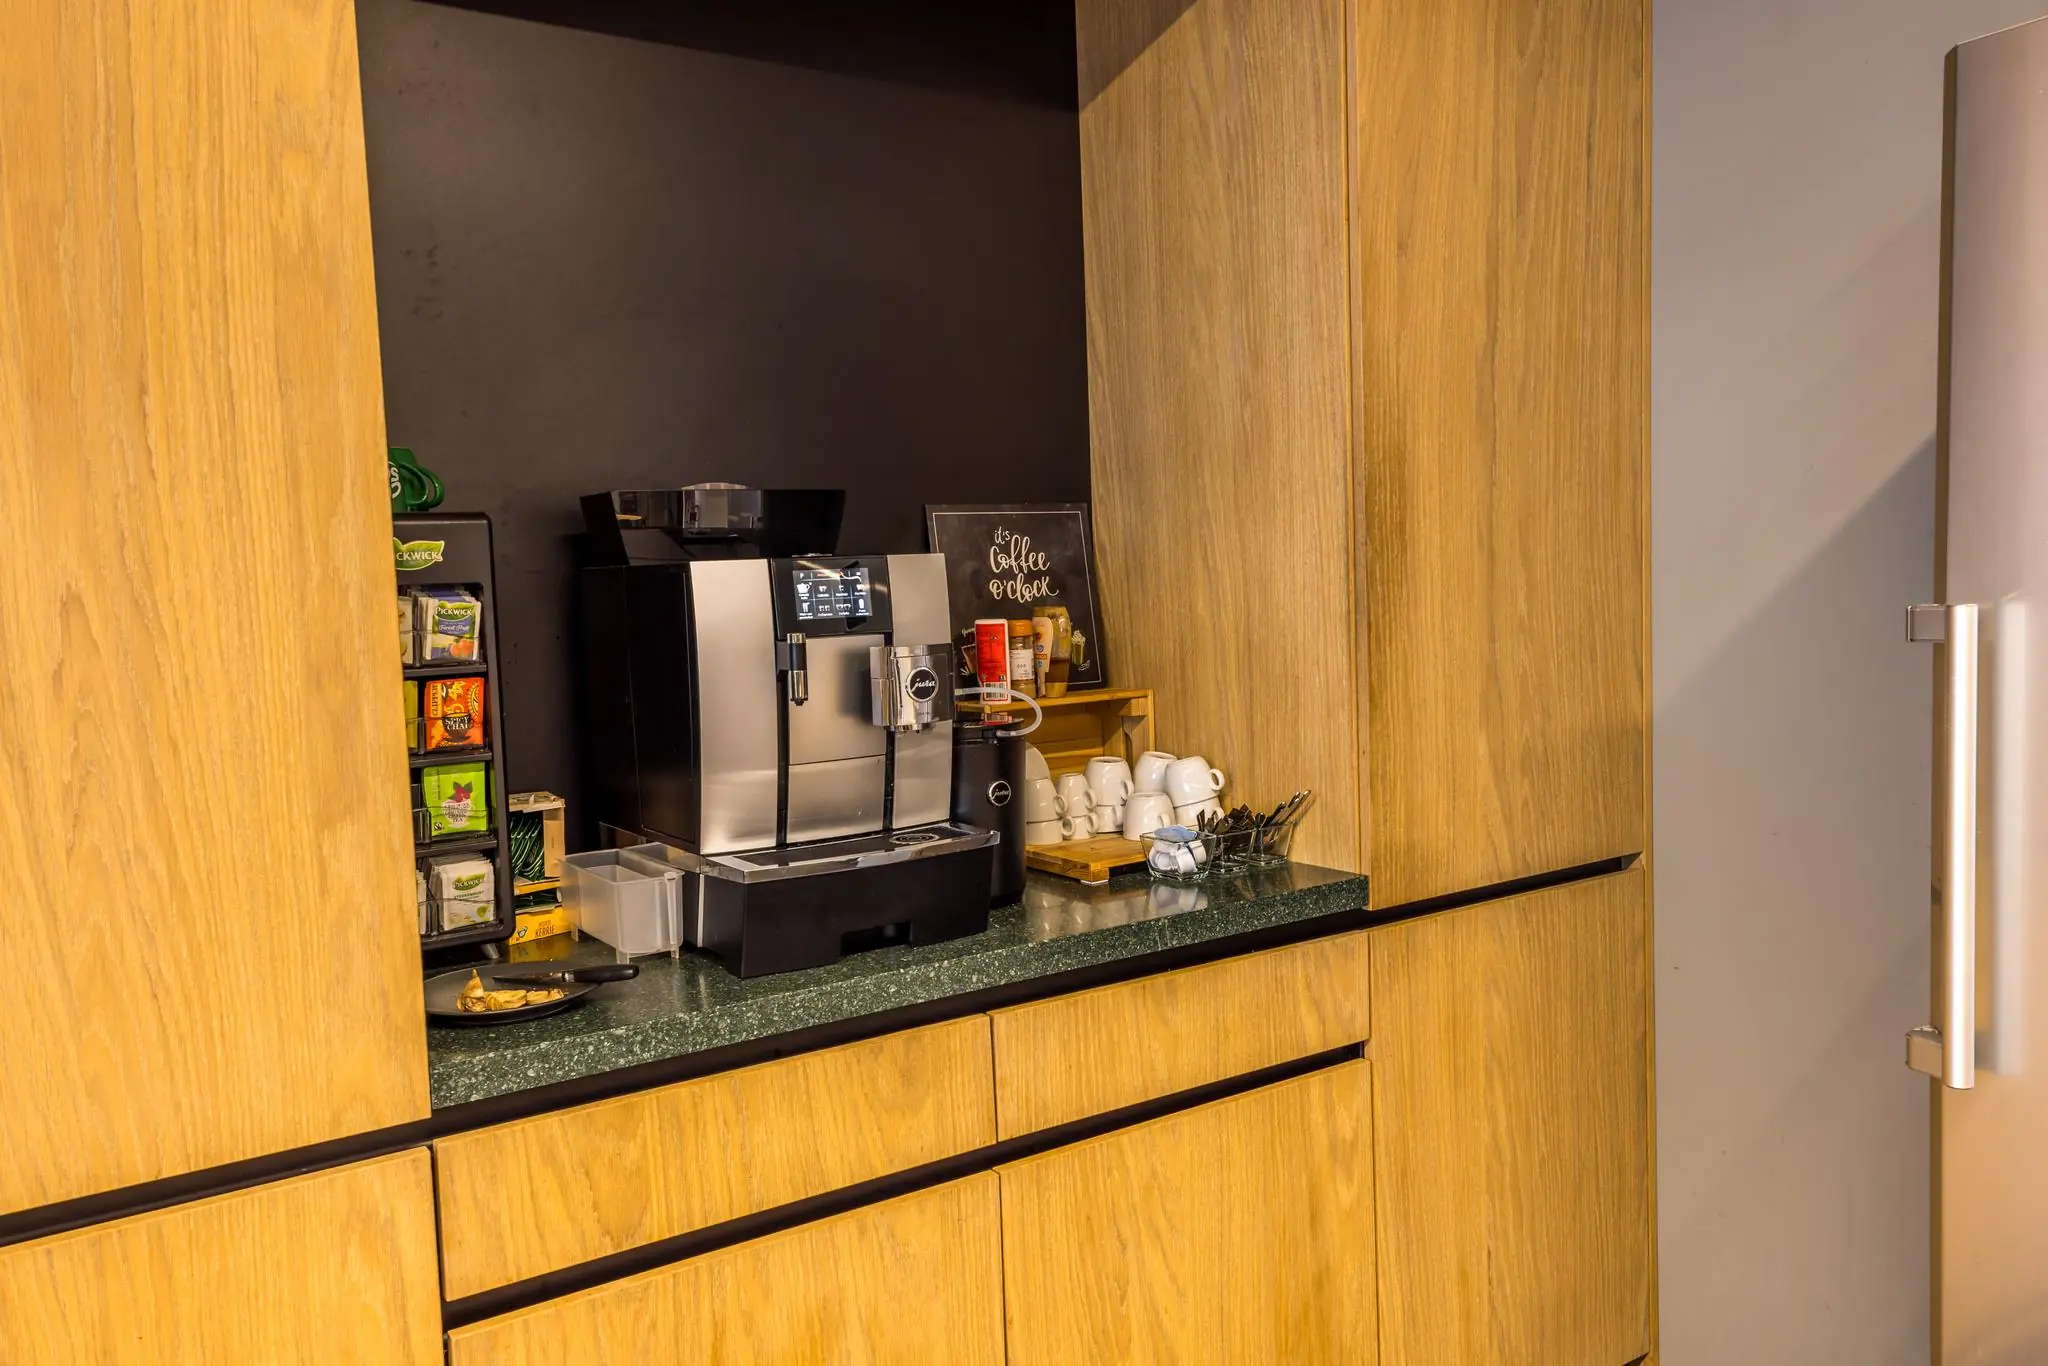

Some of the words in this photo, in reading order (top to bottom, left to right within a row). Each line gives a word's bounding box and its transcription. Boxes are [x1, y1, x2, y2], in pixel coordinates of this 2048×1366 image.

[994, 525, 1011, 545] it's
[989, 534, 1050, 574] Coffee
[435, 607, 473, 616] PICKWICK
[910, 677, 936, 693] jura
[445, 716, 470, 725] SPICY
[446, 721, 469, 731] CHAI
